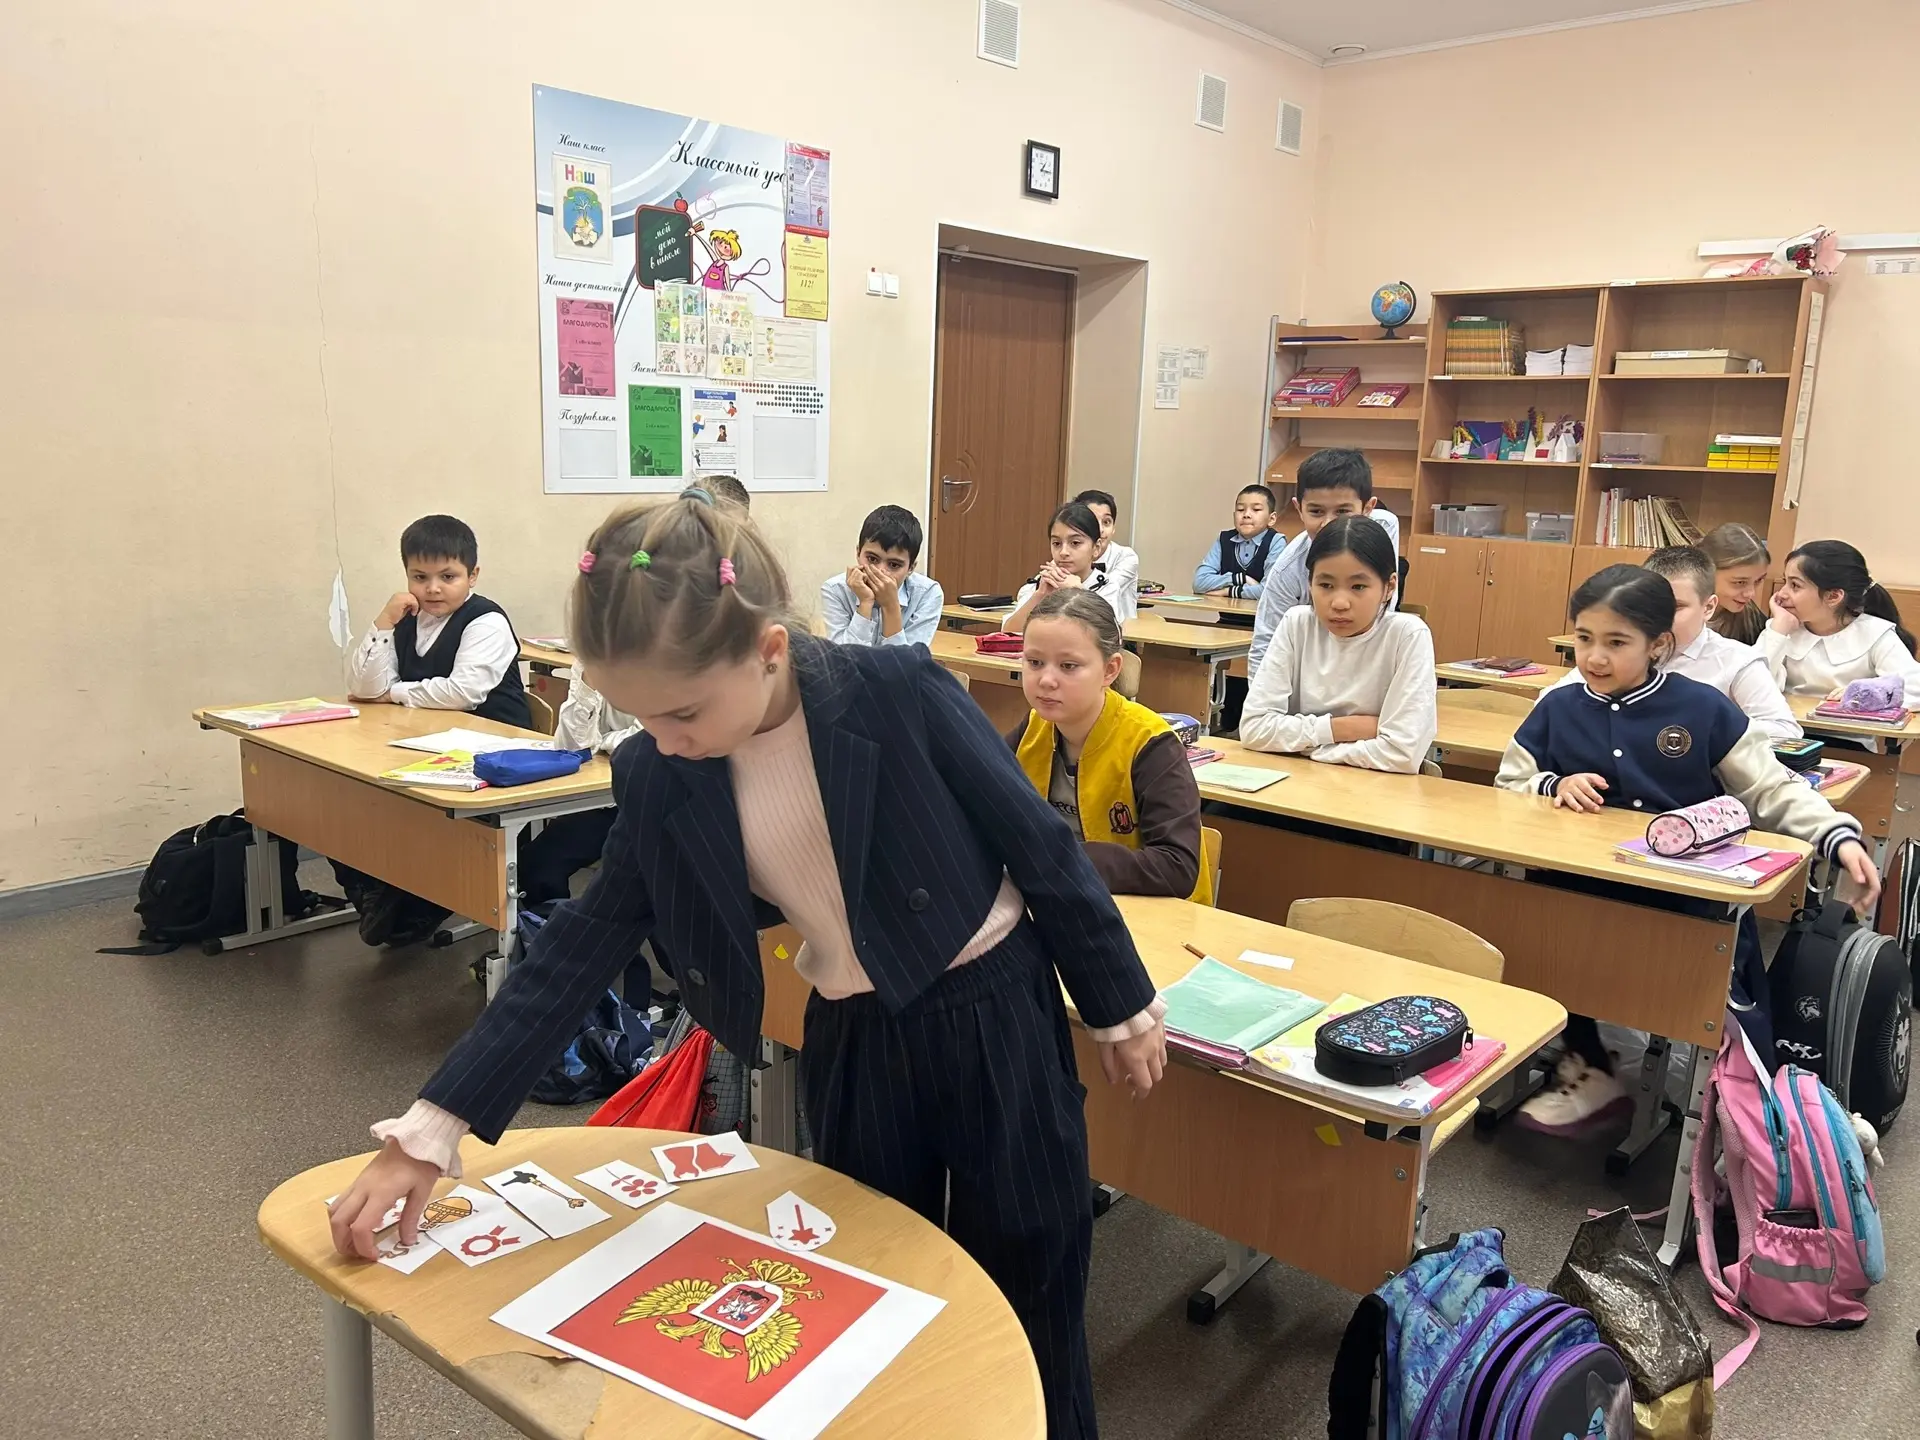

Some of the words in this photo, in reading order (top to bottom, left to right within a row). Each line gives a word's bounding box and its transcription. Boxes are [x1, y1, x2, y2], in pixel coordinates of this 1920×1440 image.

[558, 133, 581, 148] Наш
[583, 143, 606, 153] класс
[670, 140, 760, 178] Классный
[761, 170, 787, 190] уго
[565, 164, 595, 185] Наш
[654, 222, 671, 239] мой
[658, 237, 676, 256] день
[543, 273, 572, 287] Наши
[800, 279, 814, 288] 112!
[563, 319, 608, 328] БЛАГОДАРНОСТЬ
[634, 404, 676, 413] БЛАГОДАРНОСТЬ
[558, 409, 617, 425] Поздравляем
